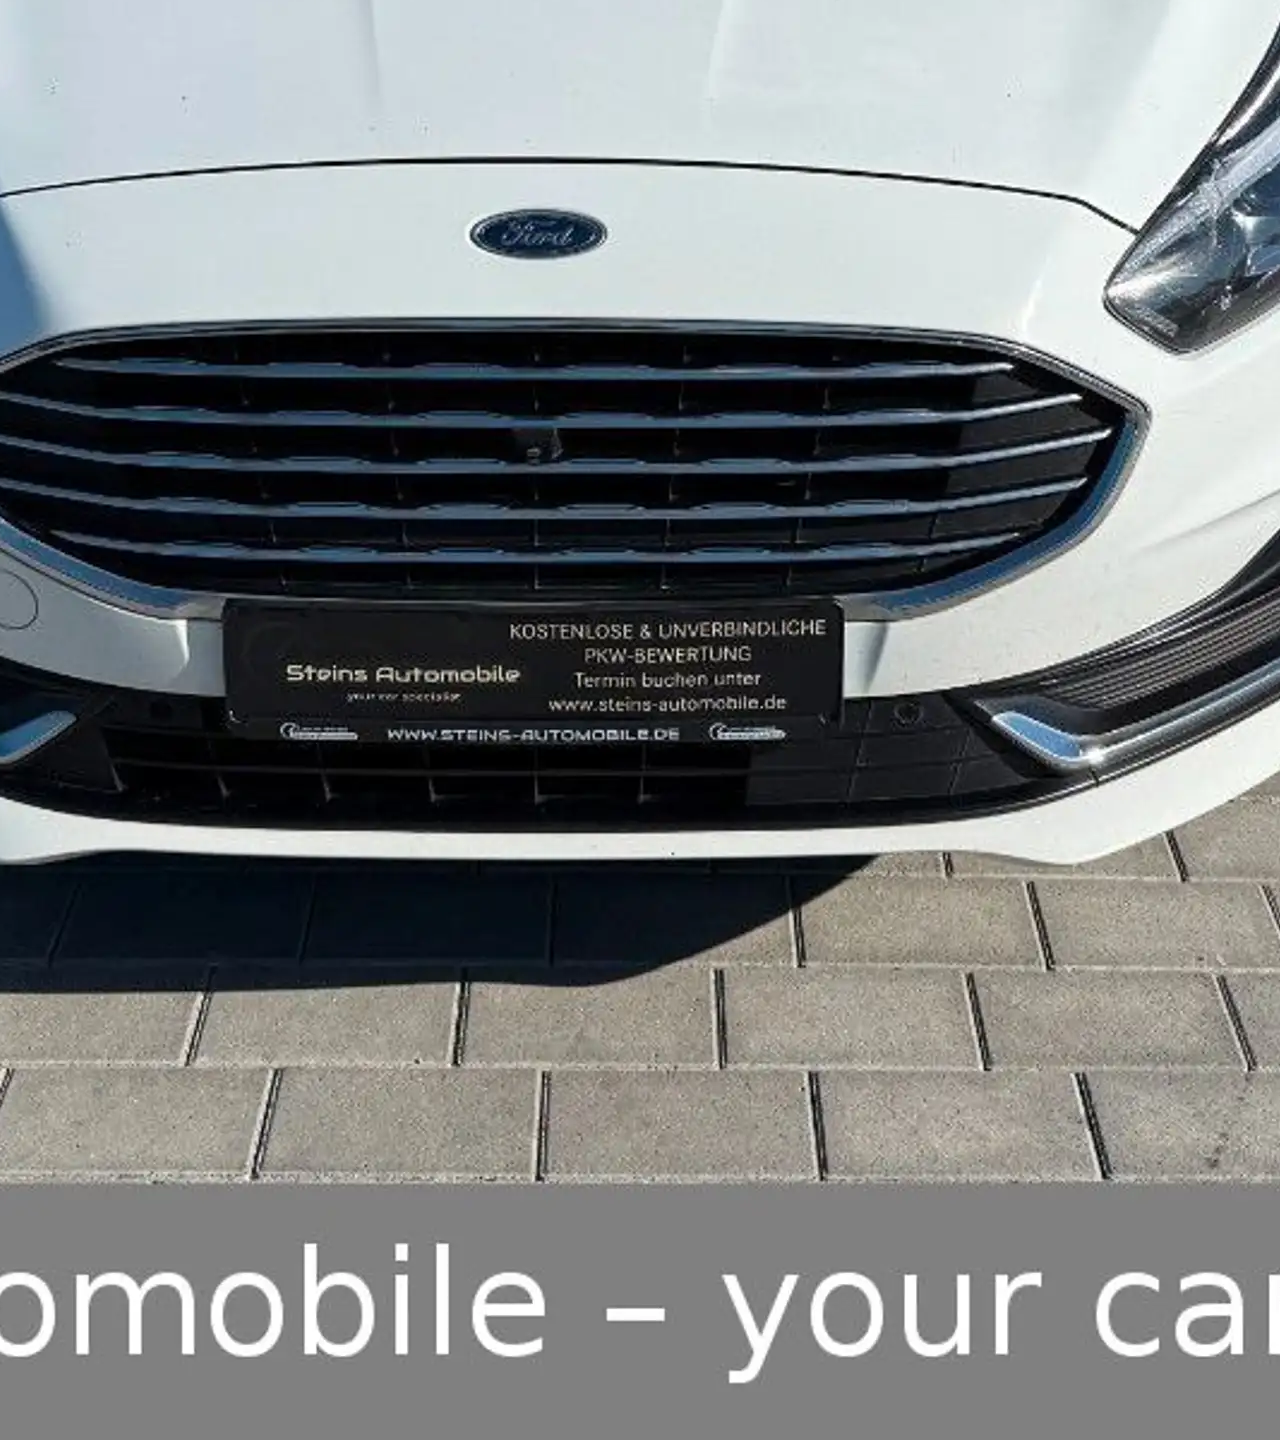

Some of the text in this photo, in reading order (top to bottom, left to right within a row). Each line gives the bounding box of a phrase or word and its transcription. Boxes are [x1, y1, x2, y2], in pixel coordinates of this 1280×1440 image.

[510, 619, 827, 640] KOSTENLOSE & UNVERBINDLICHE
[584, 645, 752, 664] PKW-BEWERTUNG
[286, 665, 521, 684] Steins Automobile
[575, 671, 762, 688] Termin buchen unter
[549, 695, 787, 712] www.steins-automobile.de
